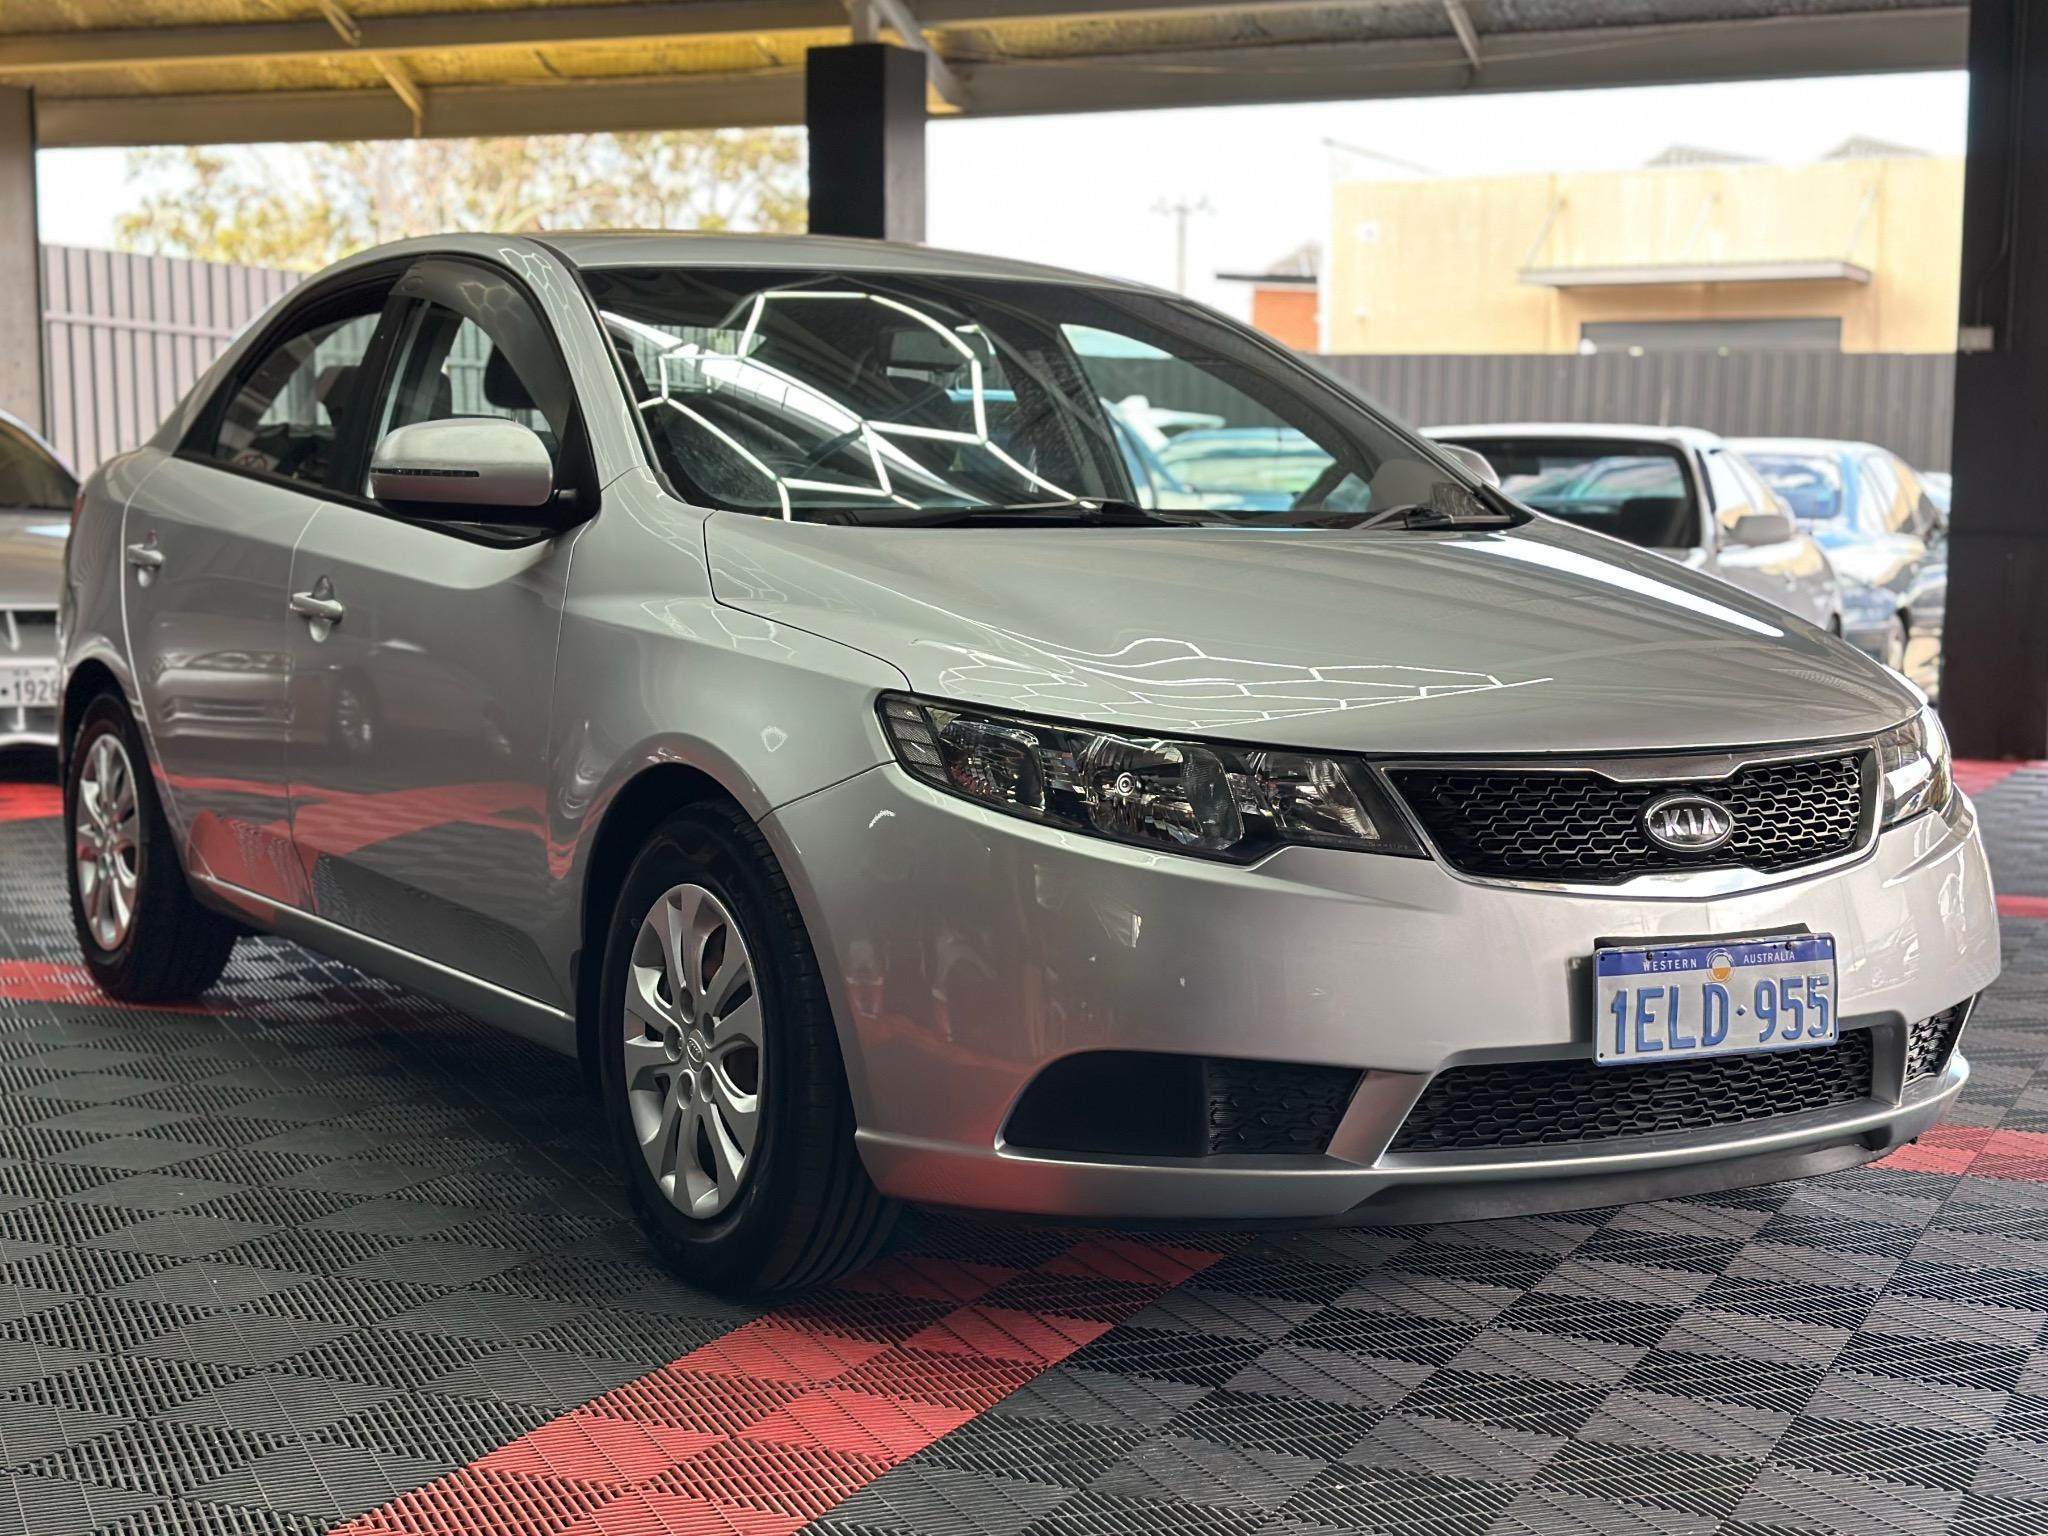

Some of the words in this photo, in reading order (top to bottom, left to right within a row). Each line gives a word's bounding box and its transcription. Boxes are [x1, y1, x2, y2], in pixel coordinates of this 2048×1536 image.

[1659, 808, 1723, 837] KIA
[1643, 959, 1697, 972] WESTERN
[1743, 950, 1795, 964] AUSTRALIA
